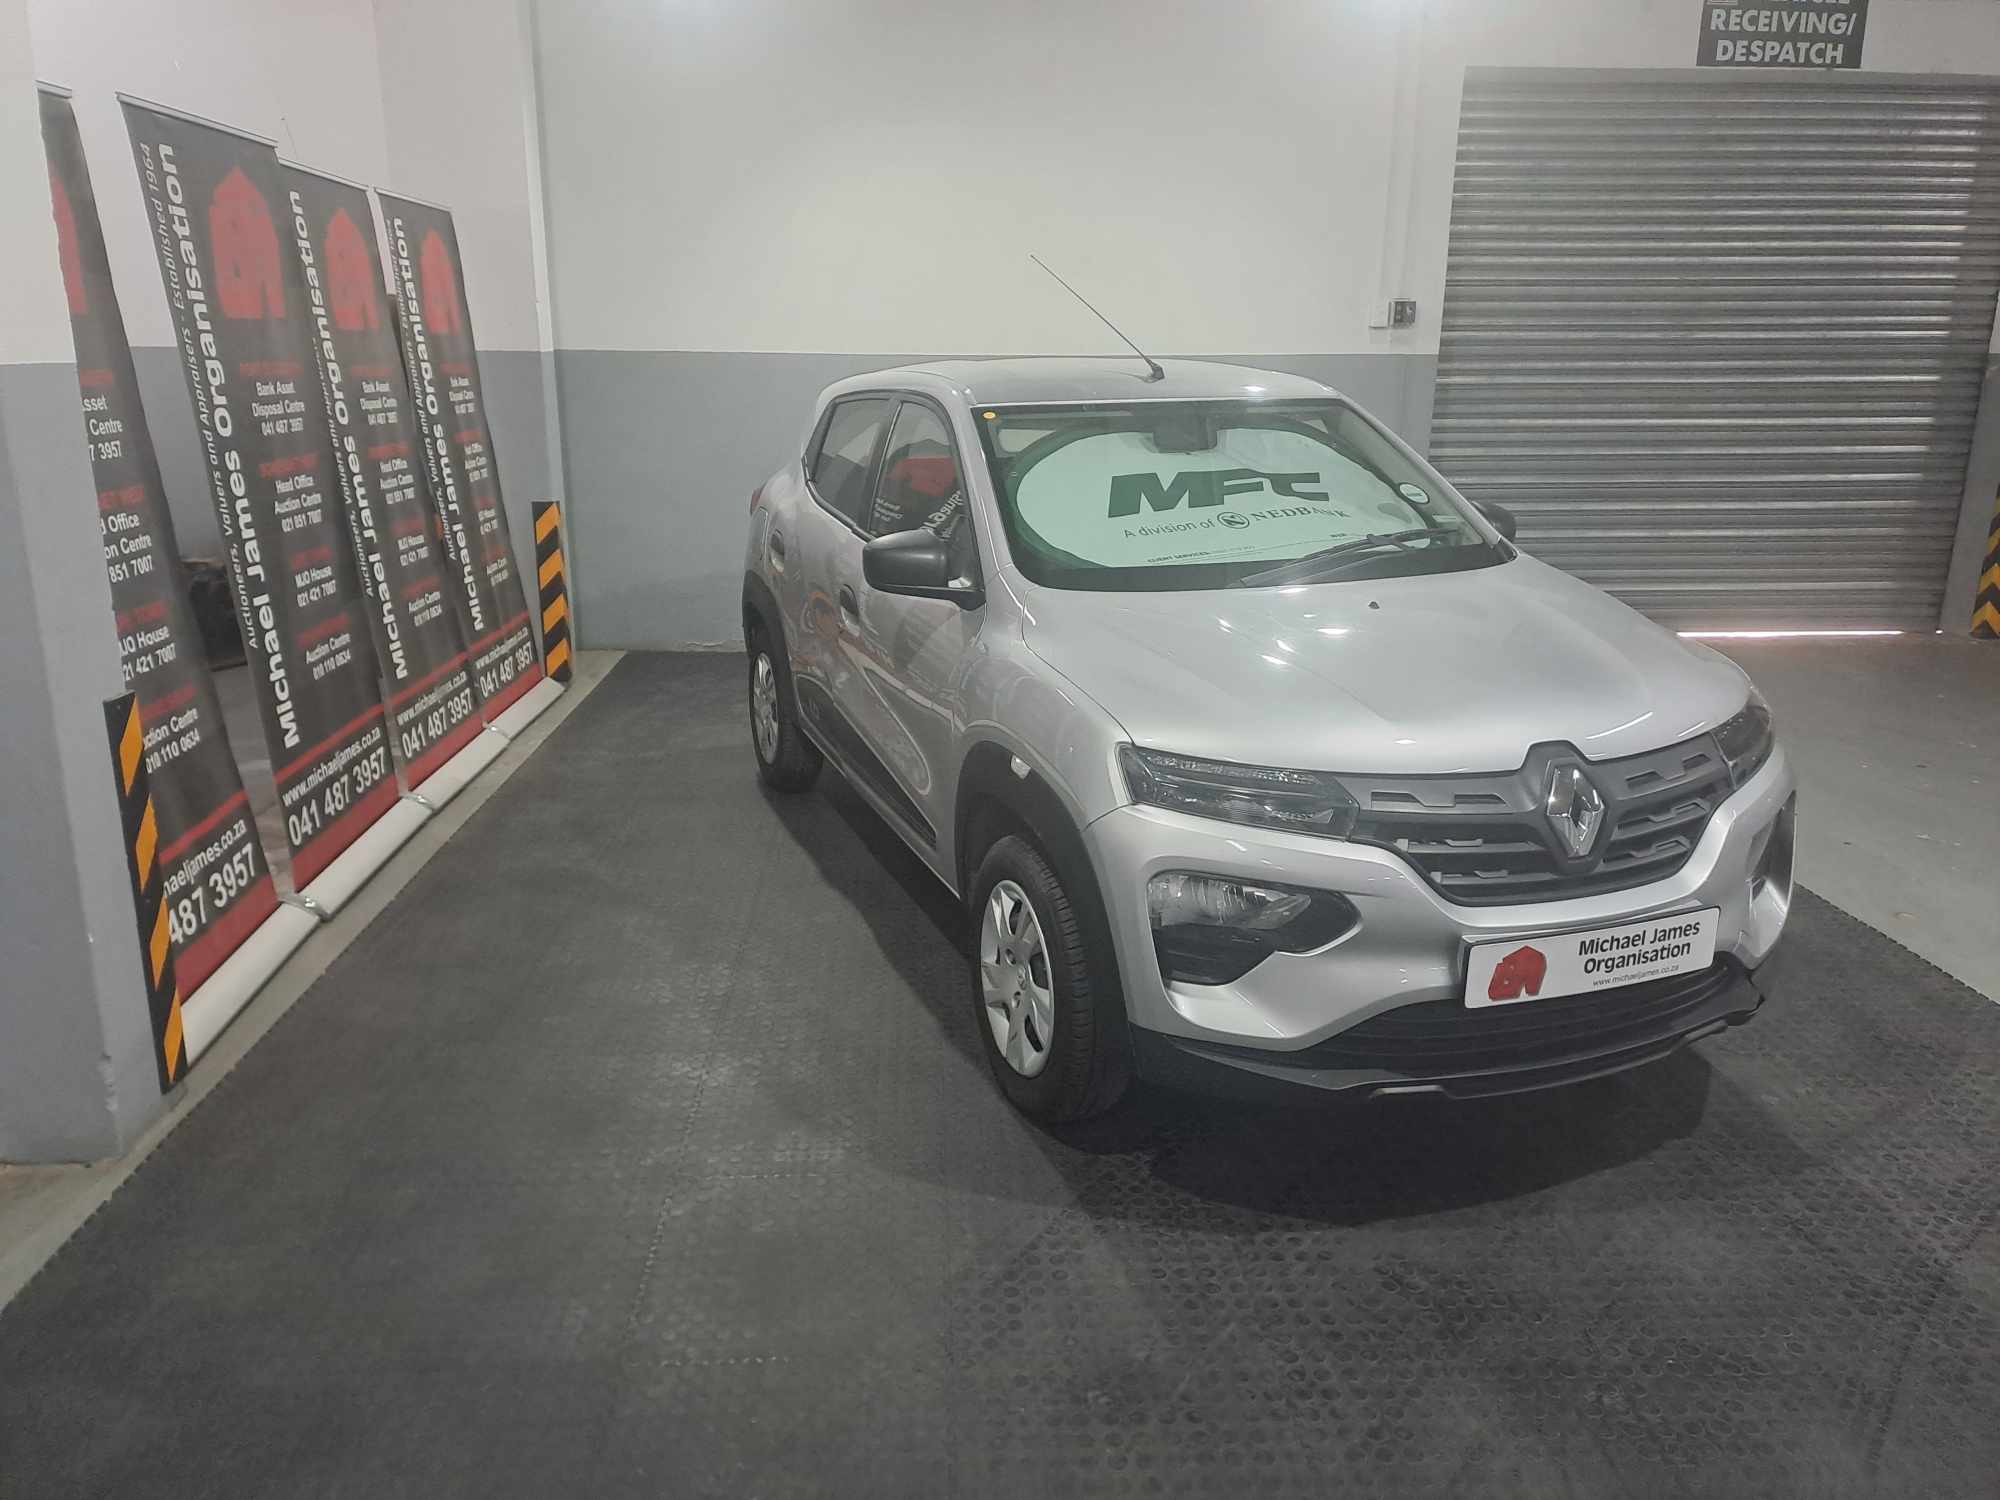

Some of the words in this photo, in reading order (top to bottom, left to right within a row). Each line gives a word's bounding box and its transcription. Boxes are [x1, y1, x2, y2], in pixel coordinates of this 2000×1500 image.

[1710, 8, 1857, 36] RECEIVING/
[1715, 39, 1844, 65] DESPATCH
[140, 142, 159, 192] 1964
[151, 198, 185, 309] Established
[158, 143, 233, 438] Organisation
[289, 191, 349, 425] Organisation
[393, 217, 438, 415] Organisation
[181, 328, 210, 426] Appraisers
[81, 395, 108, 411] sset
[89, 418, 123, 436] Centre
[418, 409, 429, 434] and
[100, 440, 122, 460] 3957
[202, 428, 219, 465] and
[433, 424, 460, 515] James
[213, 470, 233, 536] Valuers
[343, 435, 377, 544] James
[1108, 468, 1330, 518] MFC
[108, 513, 141, 534] Office
[224, 450, 266, 583] James
[1124, 529, 1136, 538] A
[1138, 521, 1197, 536] division
[1199, 518, 1215, 528] of
[1250, 505, 1351, 521] NEDBANK
[108, 564, 130, 583] 851
[131, 555, 153, 578] 7007
[120, 533, 152, 555] Centre
[229, 543, 258, 649] Auctioneers,
[452, 523, 484, 631] Michael
[119, 636, 136, 655] JO
[136, 626, 170, 648] House
[368, 553, 408, 680] Michael
[121, 661, 135, 681] 21
[136, 653, 154, 673] 421
[154, 643, 176, 665] 7007
[253, 593, 300, 749] Michael
[480, 668, 499, 698] 041
[500, 655, 514, 683] 487
[515, 640, 533, 672] 3957
[143, 727, 169, 750] ction
[170, 708, 198, 732] Centre
[402, 722, 426, 758] 041
[428, 705, 447, 739] 487
[448, 687, 472, 723] 3957
[160, 741, 180, 762] 110
[282, 726, 381, 807] www.michaeljames.co.za
[288, 799, 320, 846] 041
[324, 774, 350, 816] 487
[352, 746, 385, 793] 3957
[169, 886, 207, 944] 487
[209, 842, 255, 908] 3957
[1578, 929, 1646, 956] Michael
[1650, 921, 1700, 945] James
[1583, 941, 1691, 974] Organisation
[1592, 964, 1680, 987] www.michaeljames.co.za
